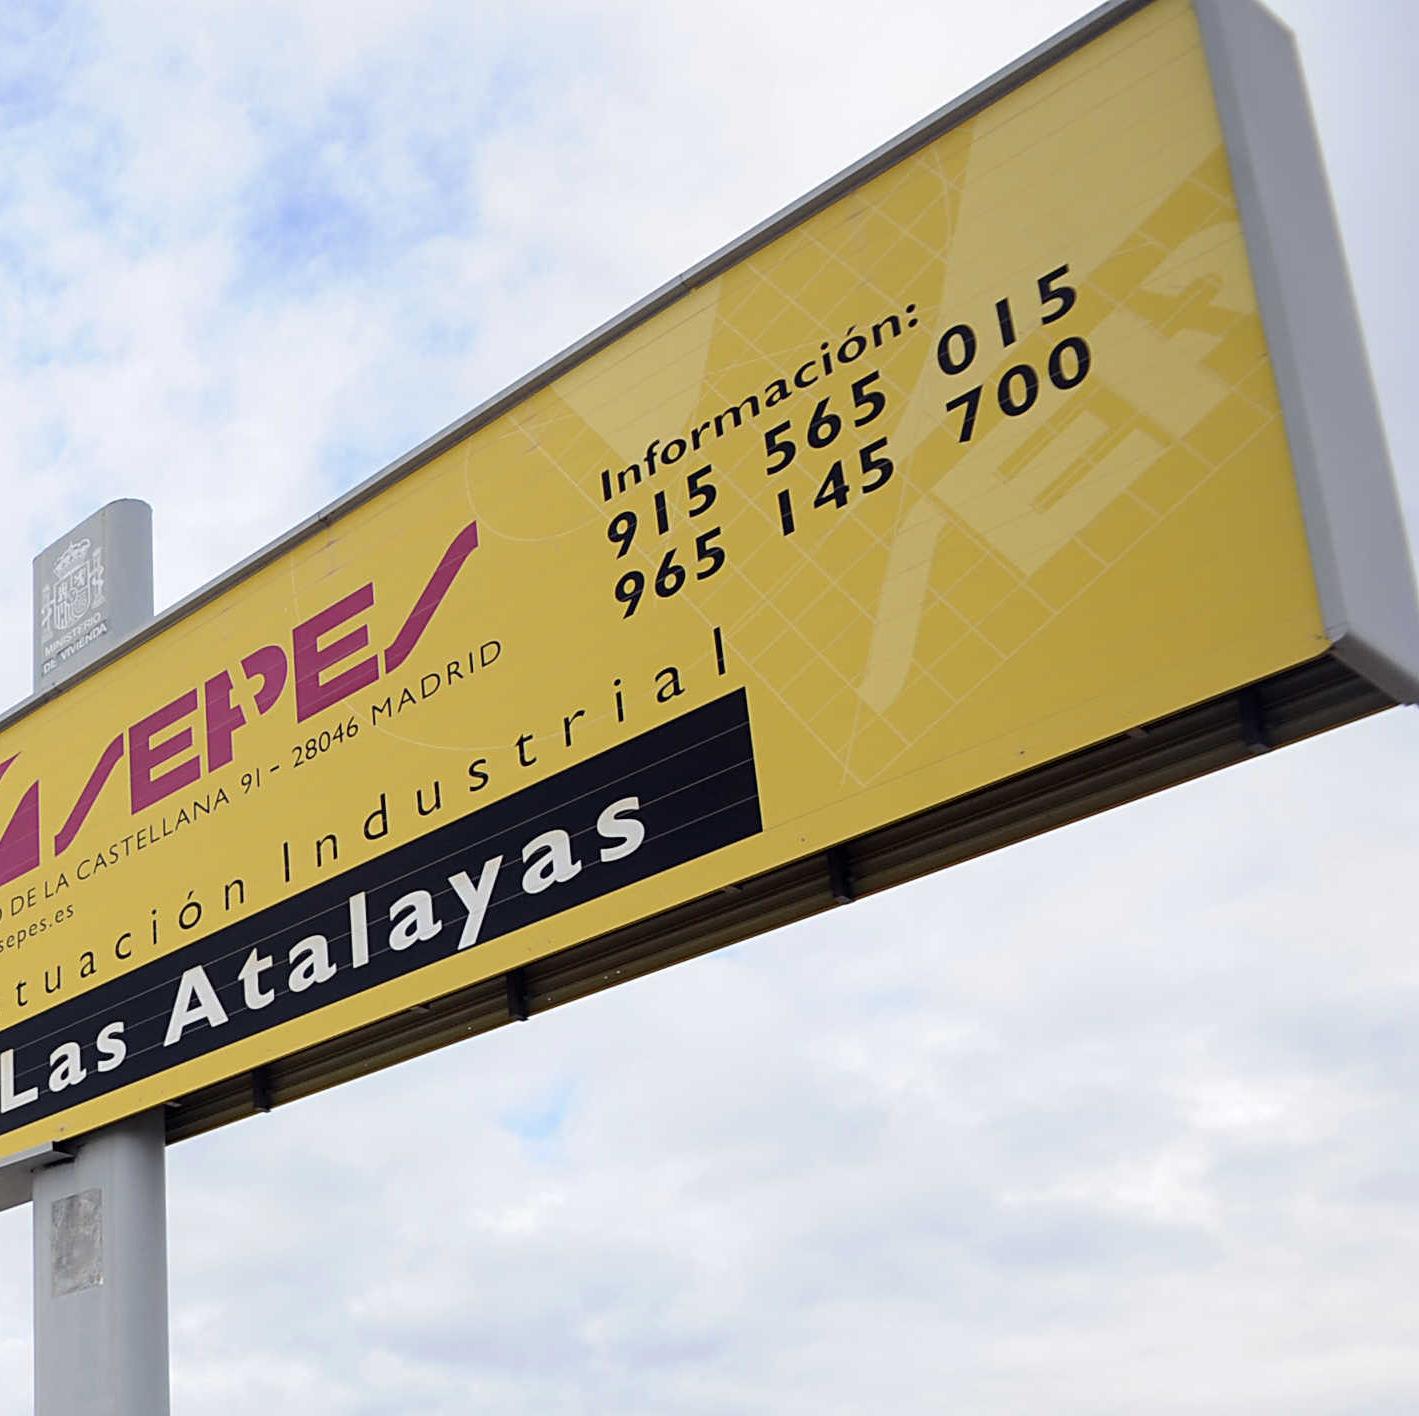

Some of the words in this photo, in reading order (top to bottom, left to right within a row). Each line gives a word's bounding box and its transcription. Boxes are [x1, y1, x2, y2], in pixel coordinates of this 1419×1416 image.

[600, 303, 919, 502] Información:
[606, 465, 718, 559] 915
[763, 370, 887, 475] 565
[936, 264, 1078, 376] 015
[614, 527, 726, 619] 965
[776, 436, 895, 536] 145
[945, 336, 1092, 443] 700
[43, 659, 58, 674] DE
[60, 622, 108, 660] VIVIENDA
[44, 612, 101, 656] MINISTERIO
[54, 520, 478, 857] SEPES
[283, 627, 727, 883] Industrial
[10, 888, 37, 917] DE
[44, 873, 70, 899] LA
[76, 788, 230, 881] CASTELLANA
[240, 768, 261, 794] 91
[291, 716, 359, 768] 28046
[371, 640, 502, 726] MADRID
[0, 1020, 128, 1114] Las
[163, 796, 646, 1047] Atalayas
